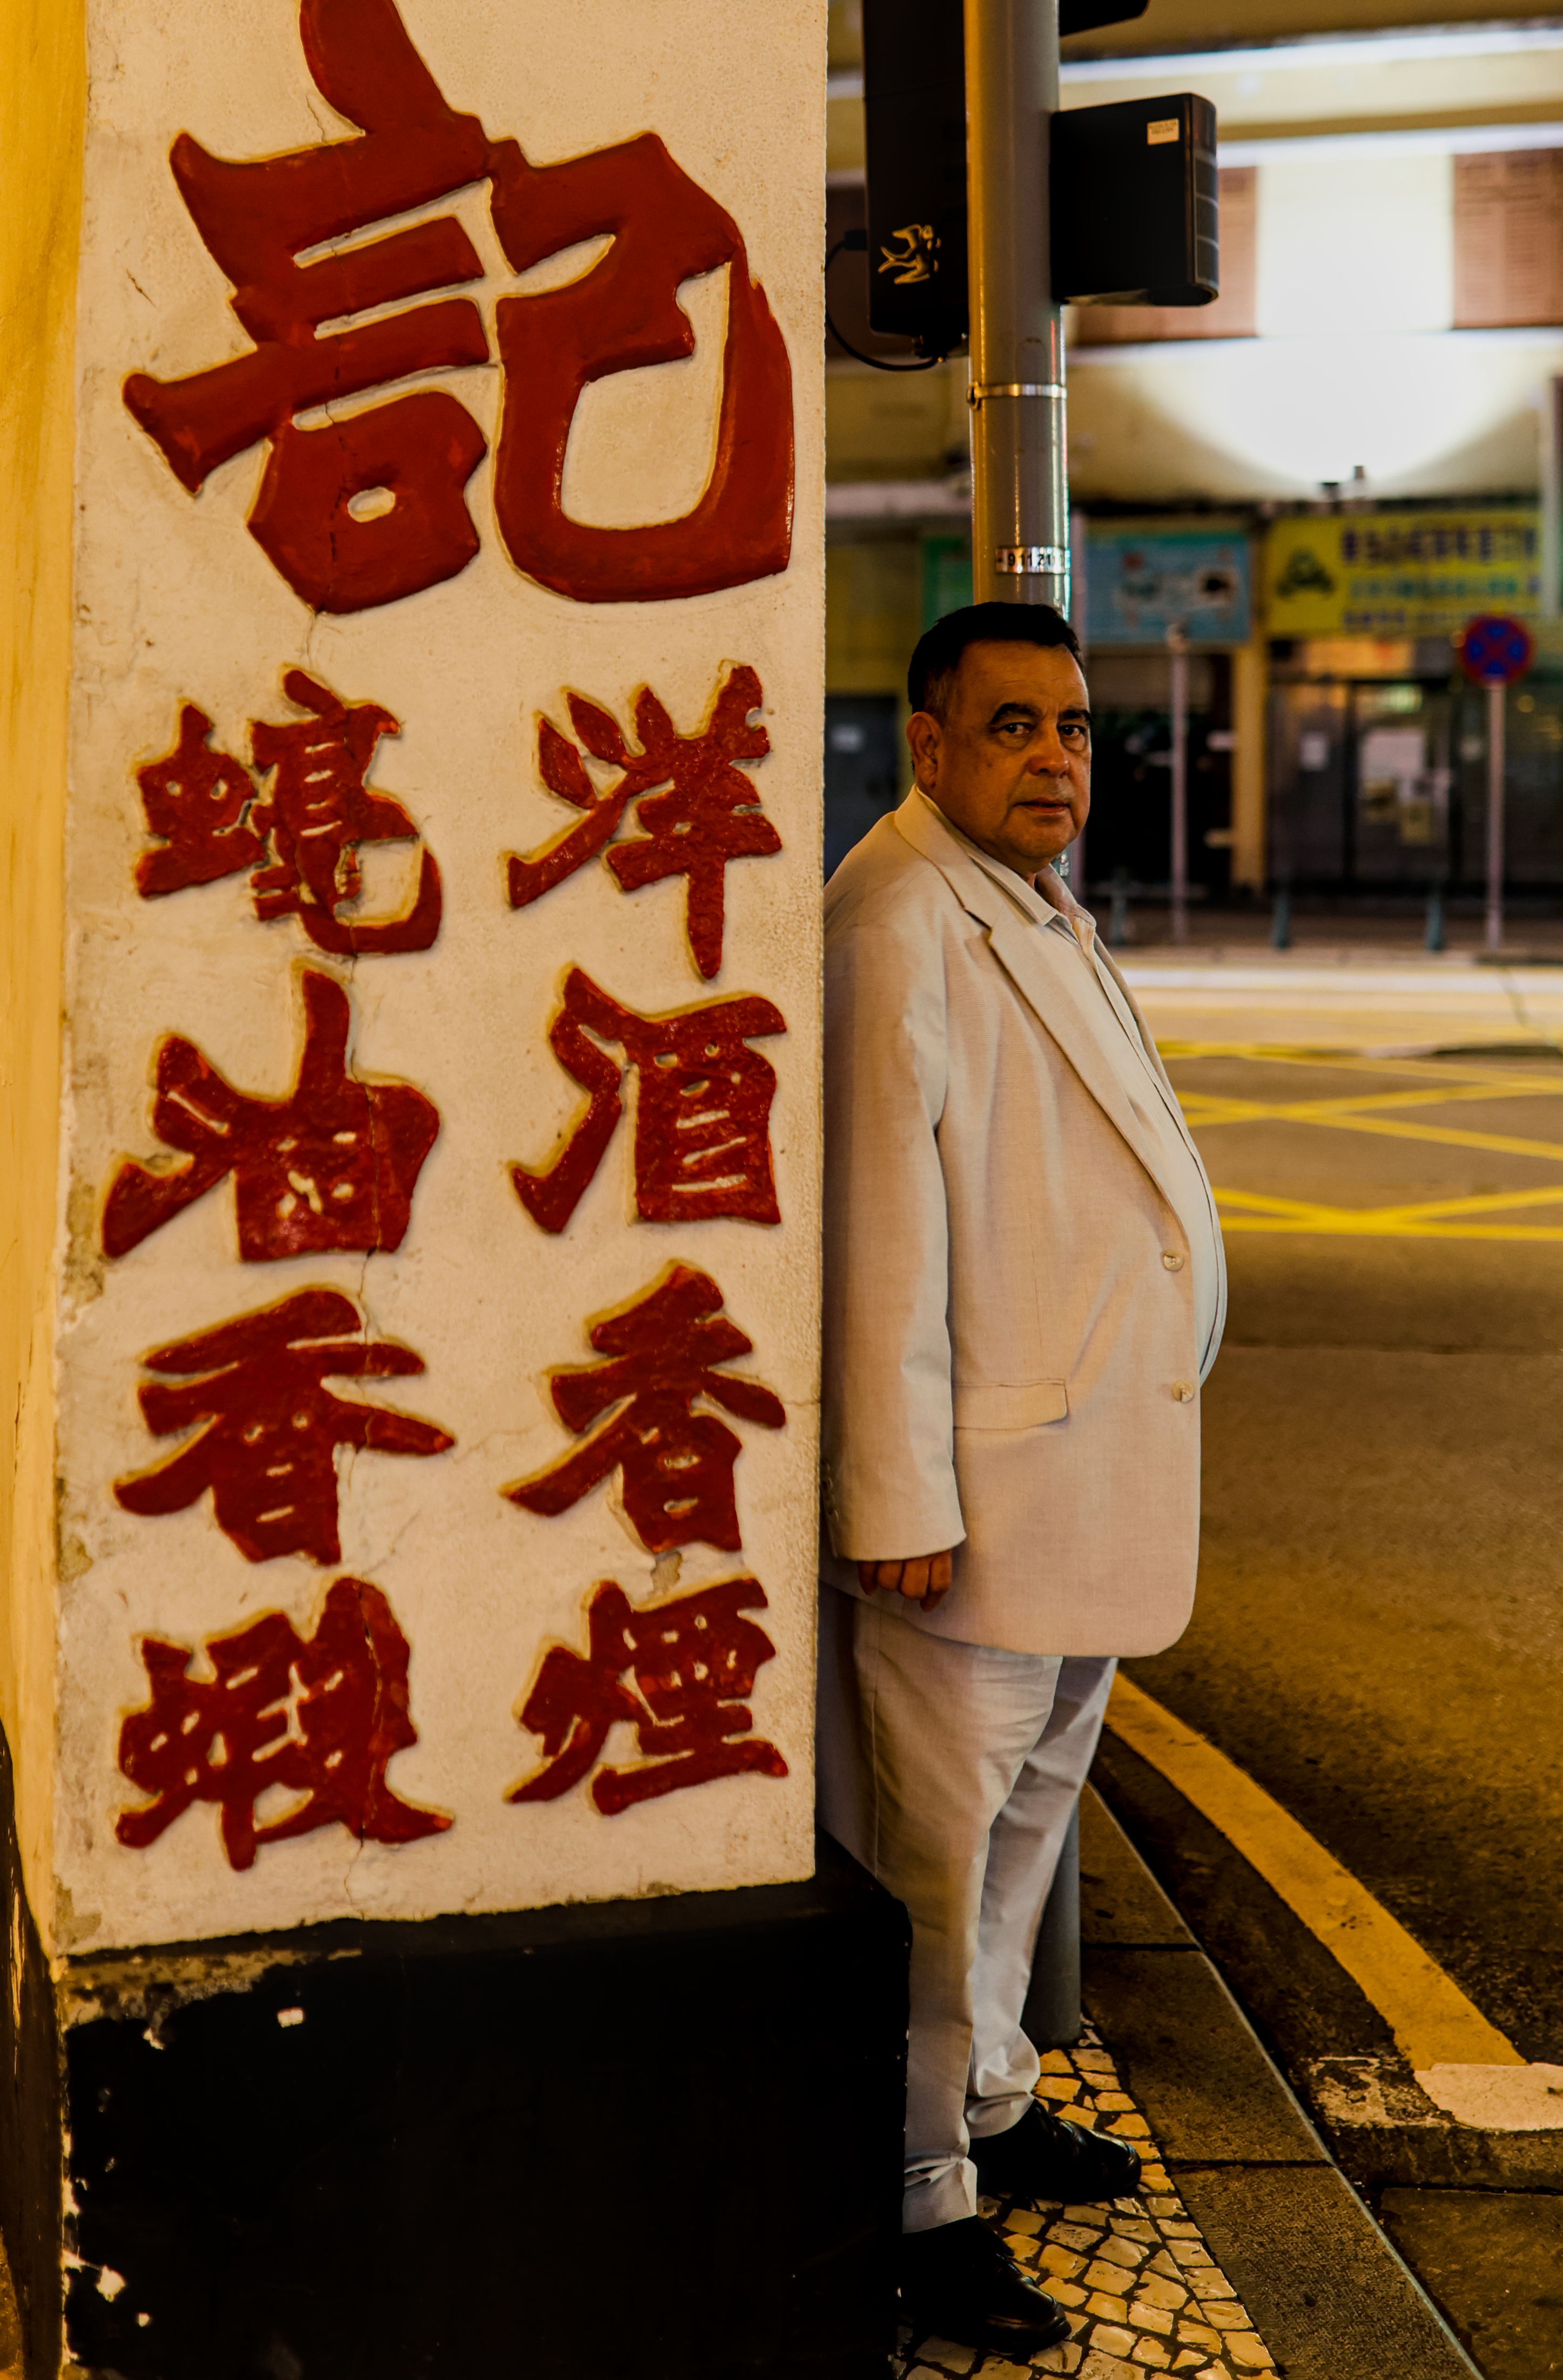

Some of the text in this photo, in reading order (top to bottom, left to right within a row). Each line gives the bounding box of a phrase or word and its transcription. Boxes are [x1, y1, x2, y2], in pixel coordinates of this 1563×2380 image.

[123, 0, 794, 616] 記
[506, 666, 788, 1816] 洋酒香煙
